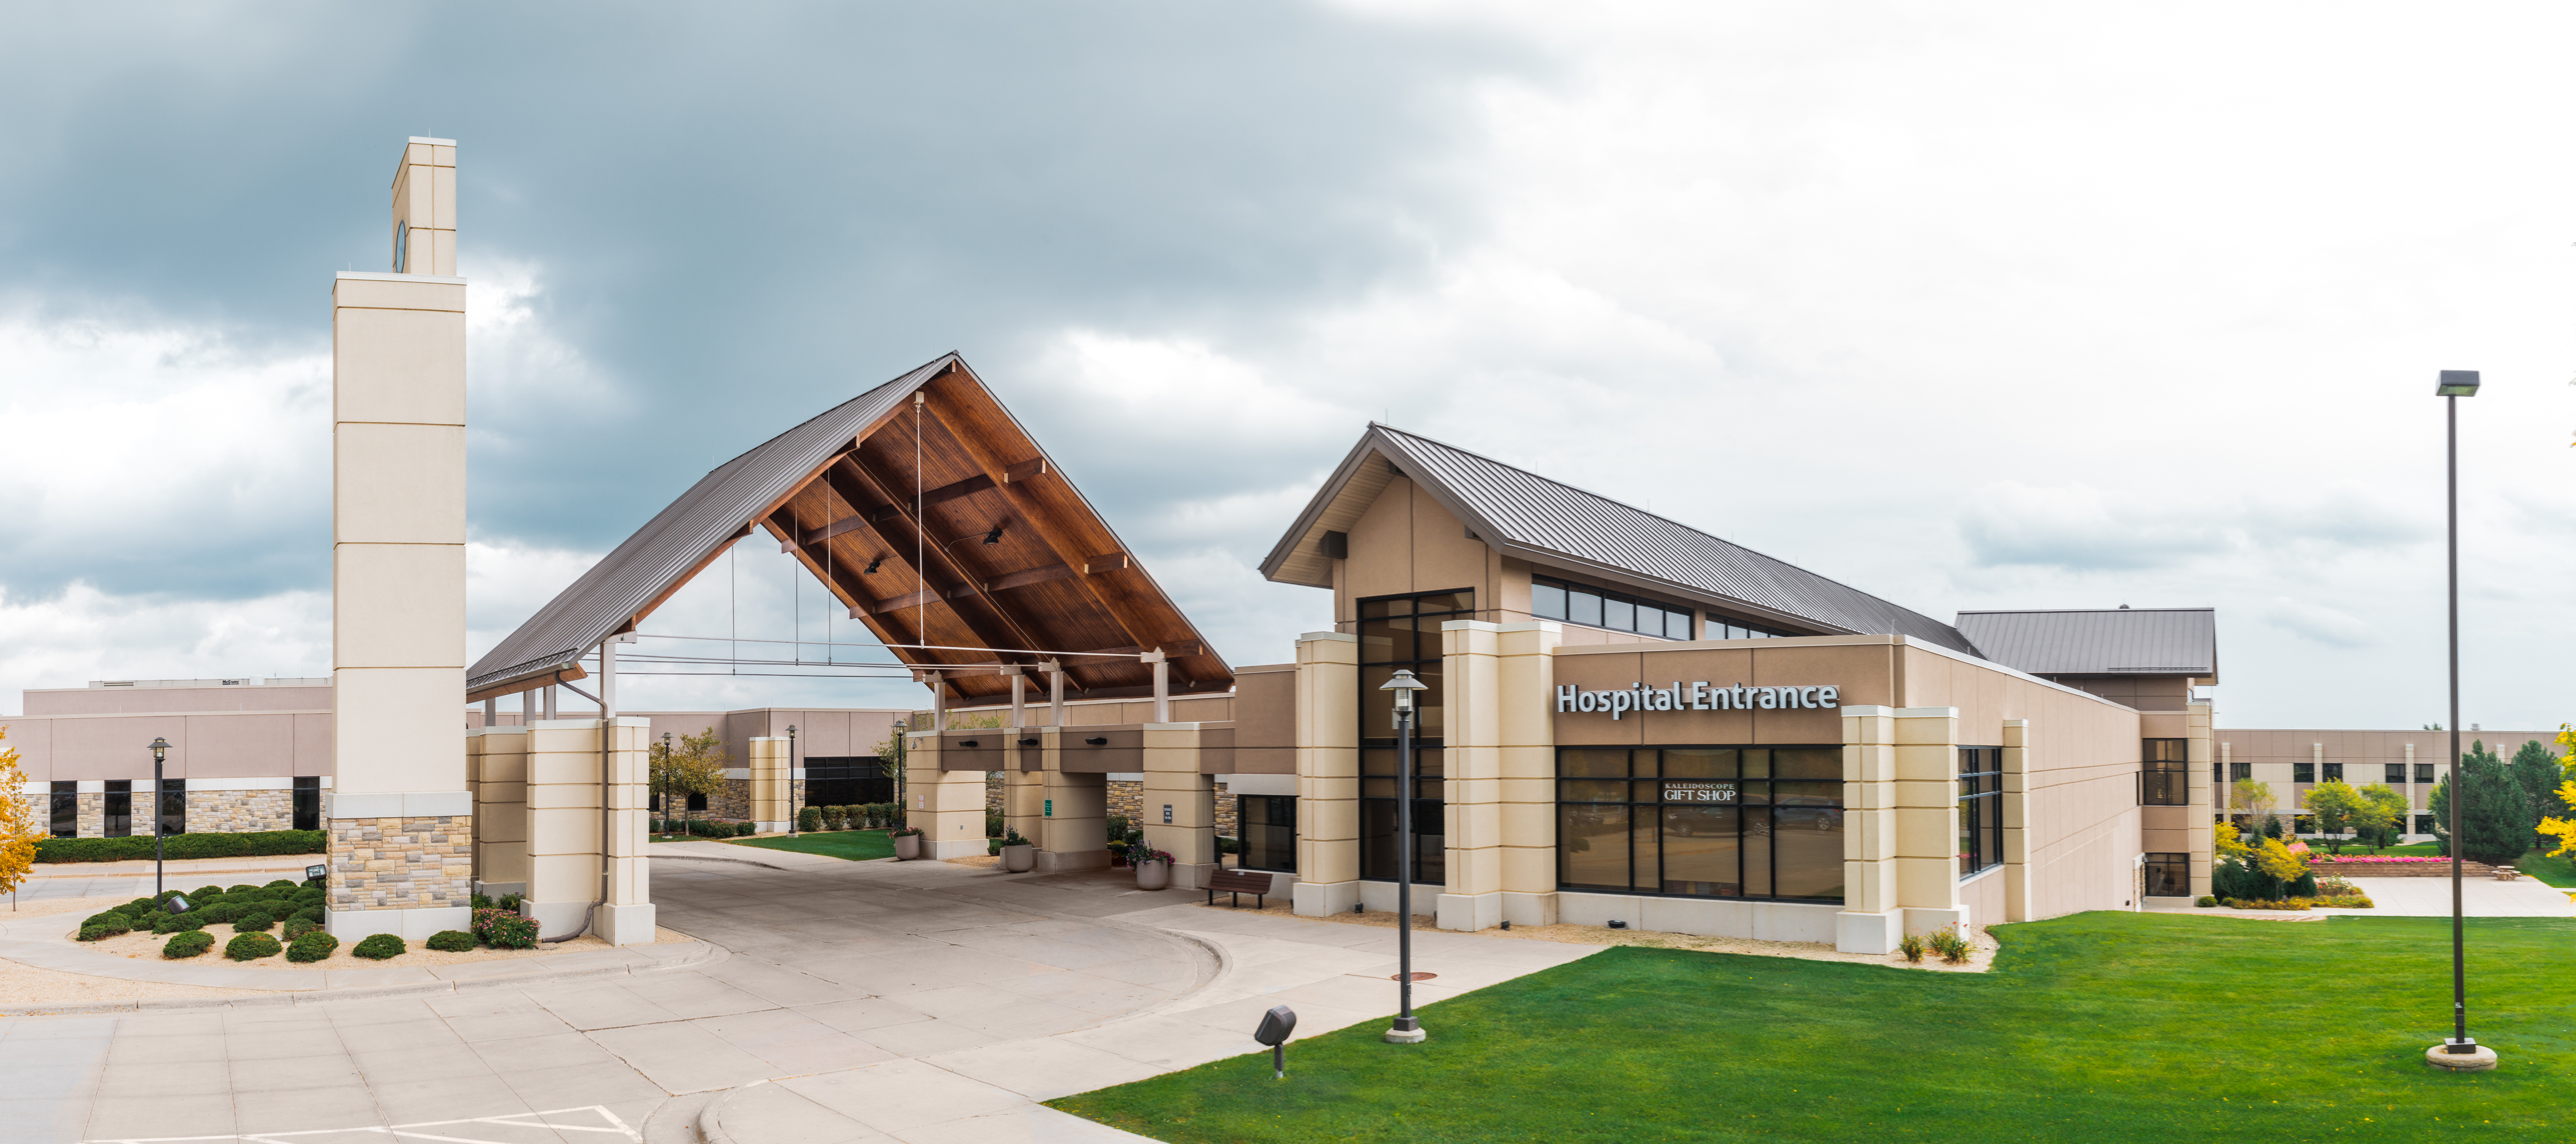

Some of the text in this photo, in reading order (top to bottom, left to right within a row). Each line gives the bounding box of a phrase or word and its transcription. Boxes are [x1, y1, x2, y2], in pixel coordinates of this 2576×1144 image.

[1557, 680, 1839, 721] Hospital Entrance
[1664, 789, 1736, 801] GIFT SHOP
